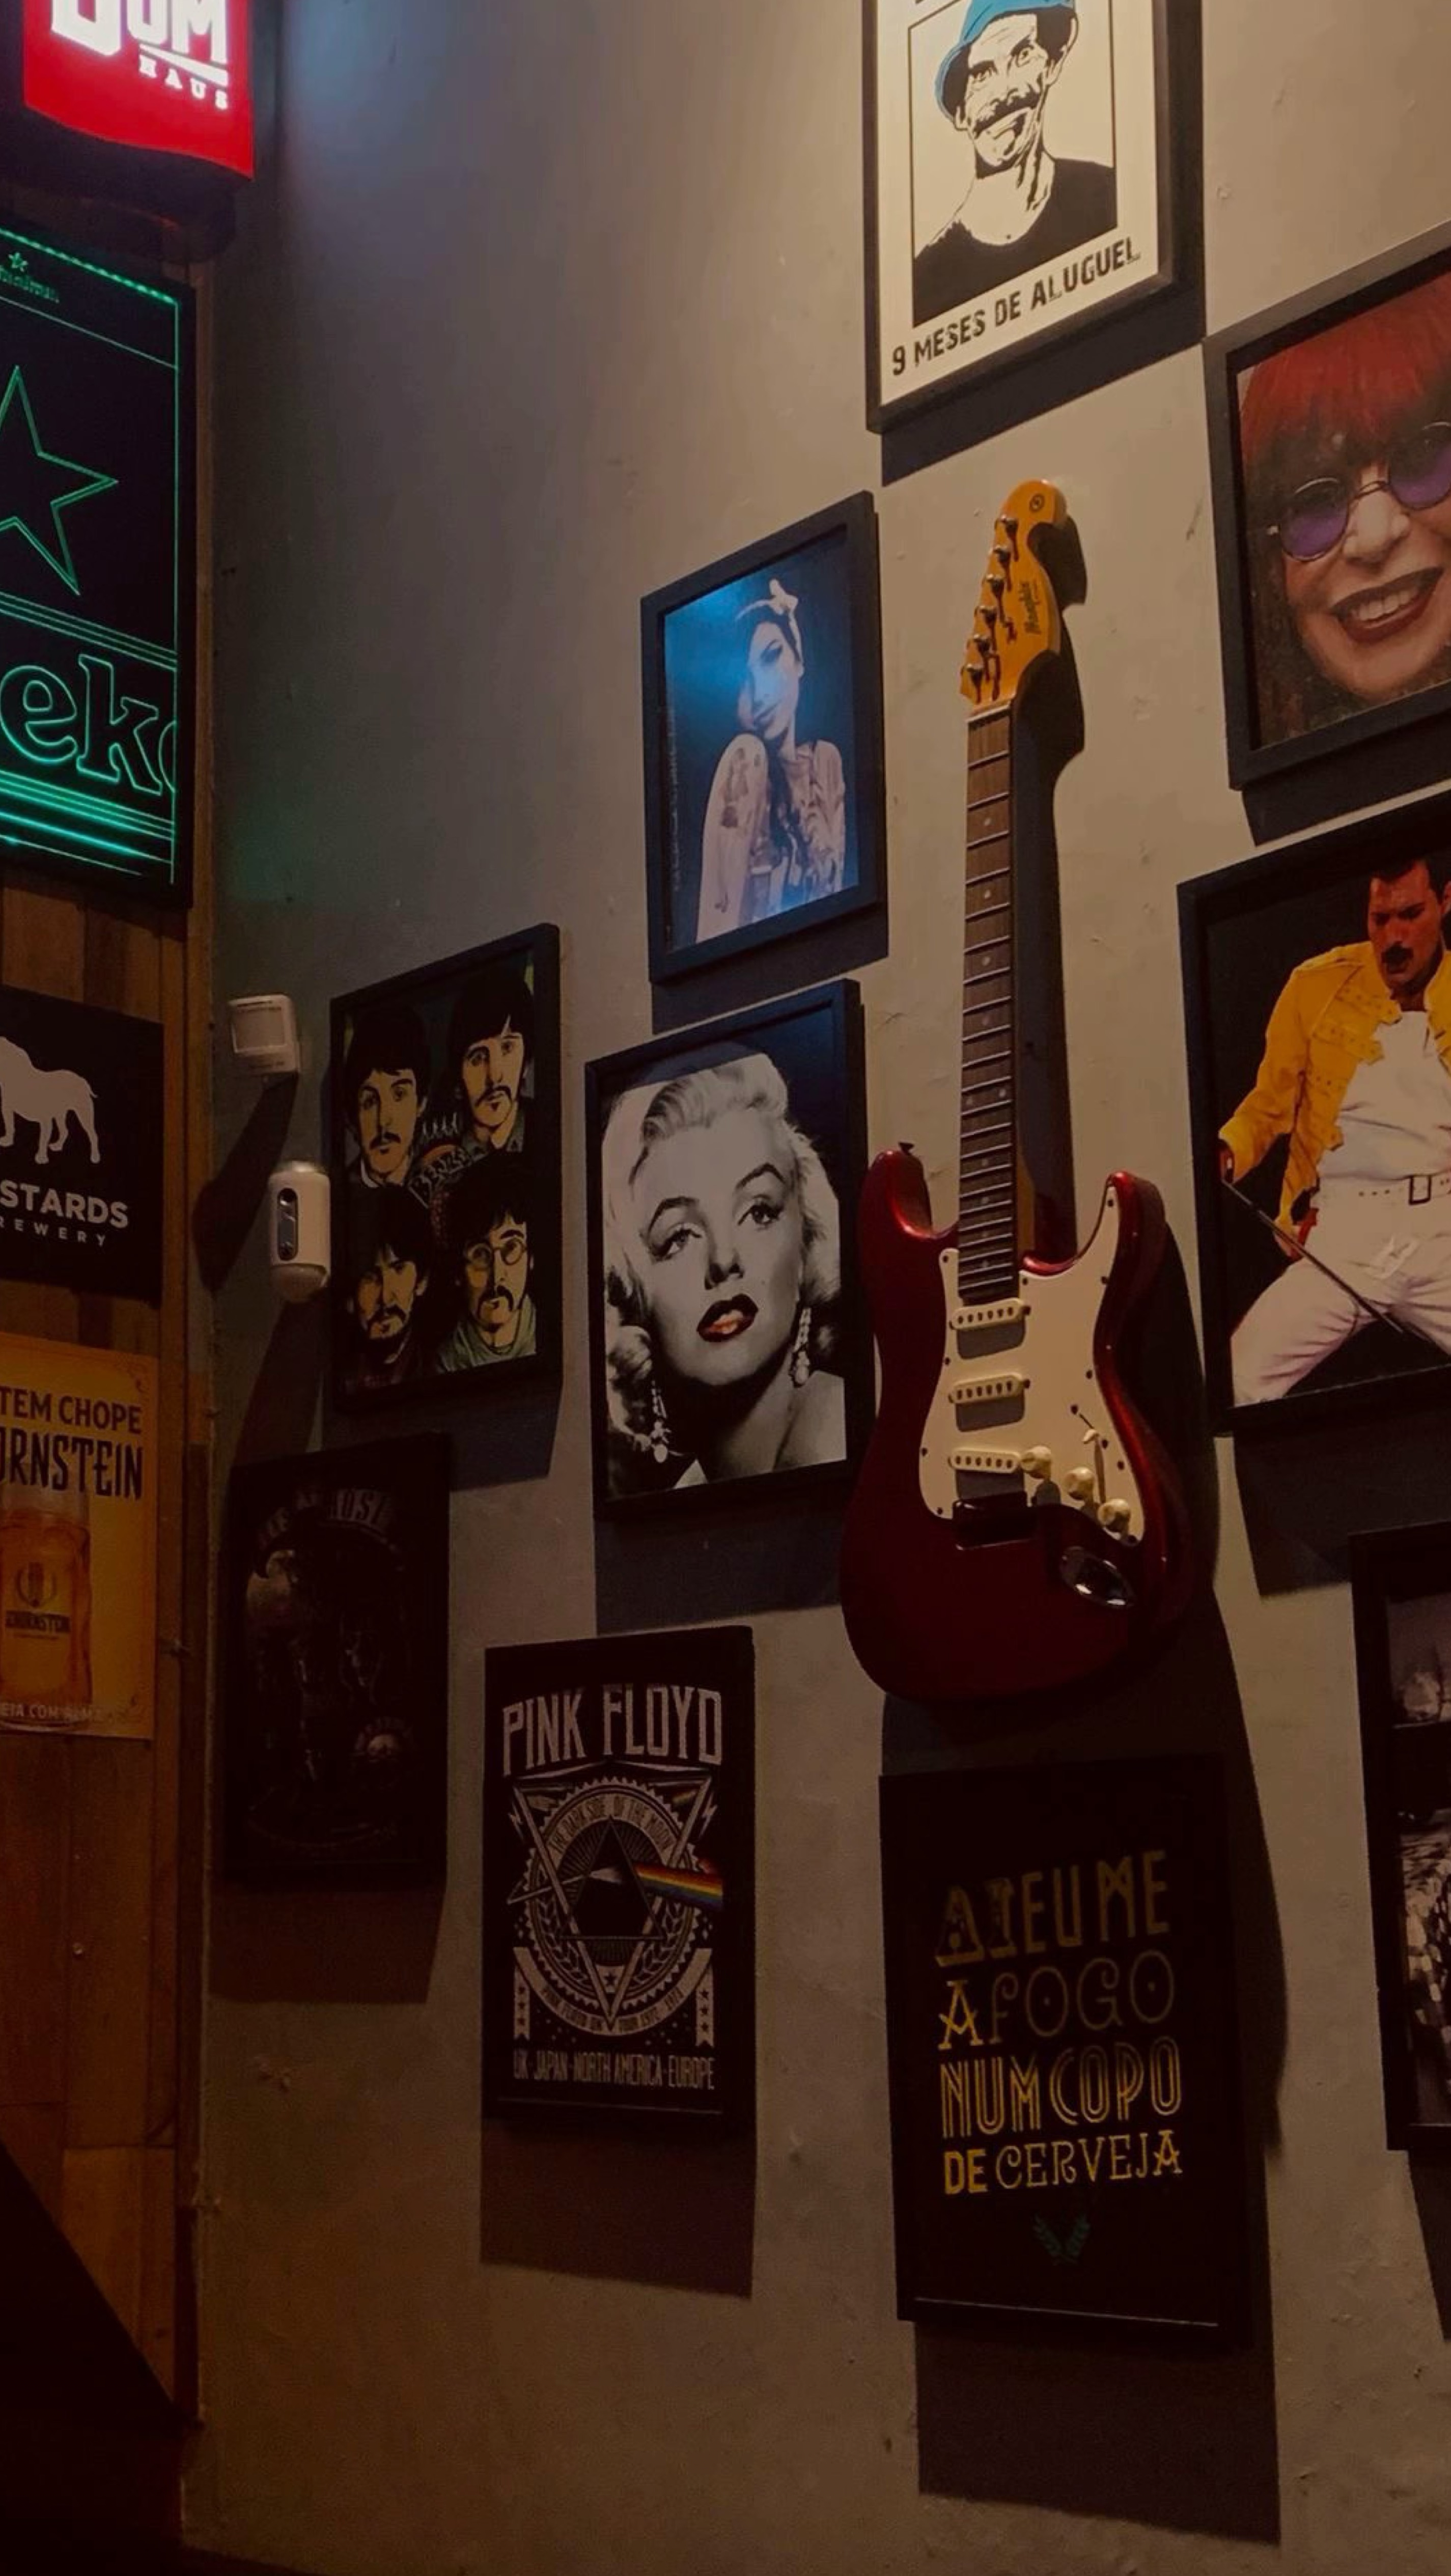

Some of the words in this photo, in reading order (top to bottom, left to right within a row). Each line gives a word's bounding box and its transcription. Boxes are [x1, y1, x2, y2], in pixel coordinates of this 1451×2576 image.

[892, 346, 906, 376] 9
[913, 310, 986, 366] MESES
[995, 291, 1021, 327] DE
[1030, 237, 1141, 309] ALUGUEL
[0, 654, 176, 795] ek
[0, 1179, 129, 1229] STARDS
[0, 1386, 52, 1422] TEM
[60, 1395, 143, 1434] CHOPE
[0, 1427, 143, 1500] RNSTEIN
[502, 1688, 588, 1778] PINK
[602, 1683, 722, 1766] FLOYD
[668, 2055, 715, 2090] EUROPE
[938, 2051, 1043, 2139] NUM
[1048, 2035, 1182, 2127] COPO
[943, 2148, 988, 2196] DE
[994, 2129, 1184, 2190] CERVEJA
